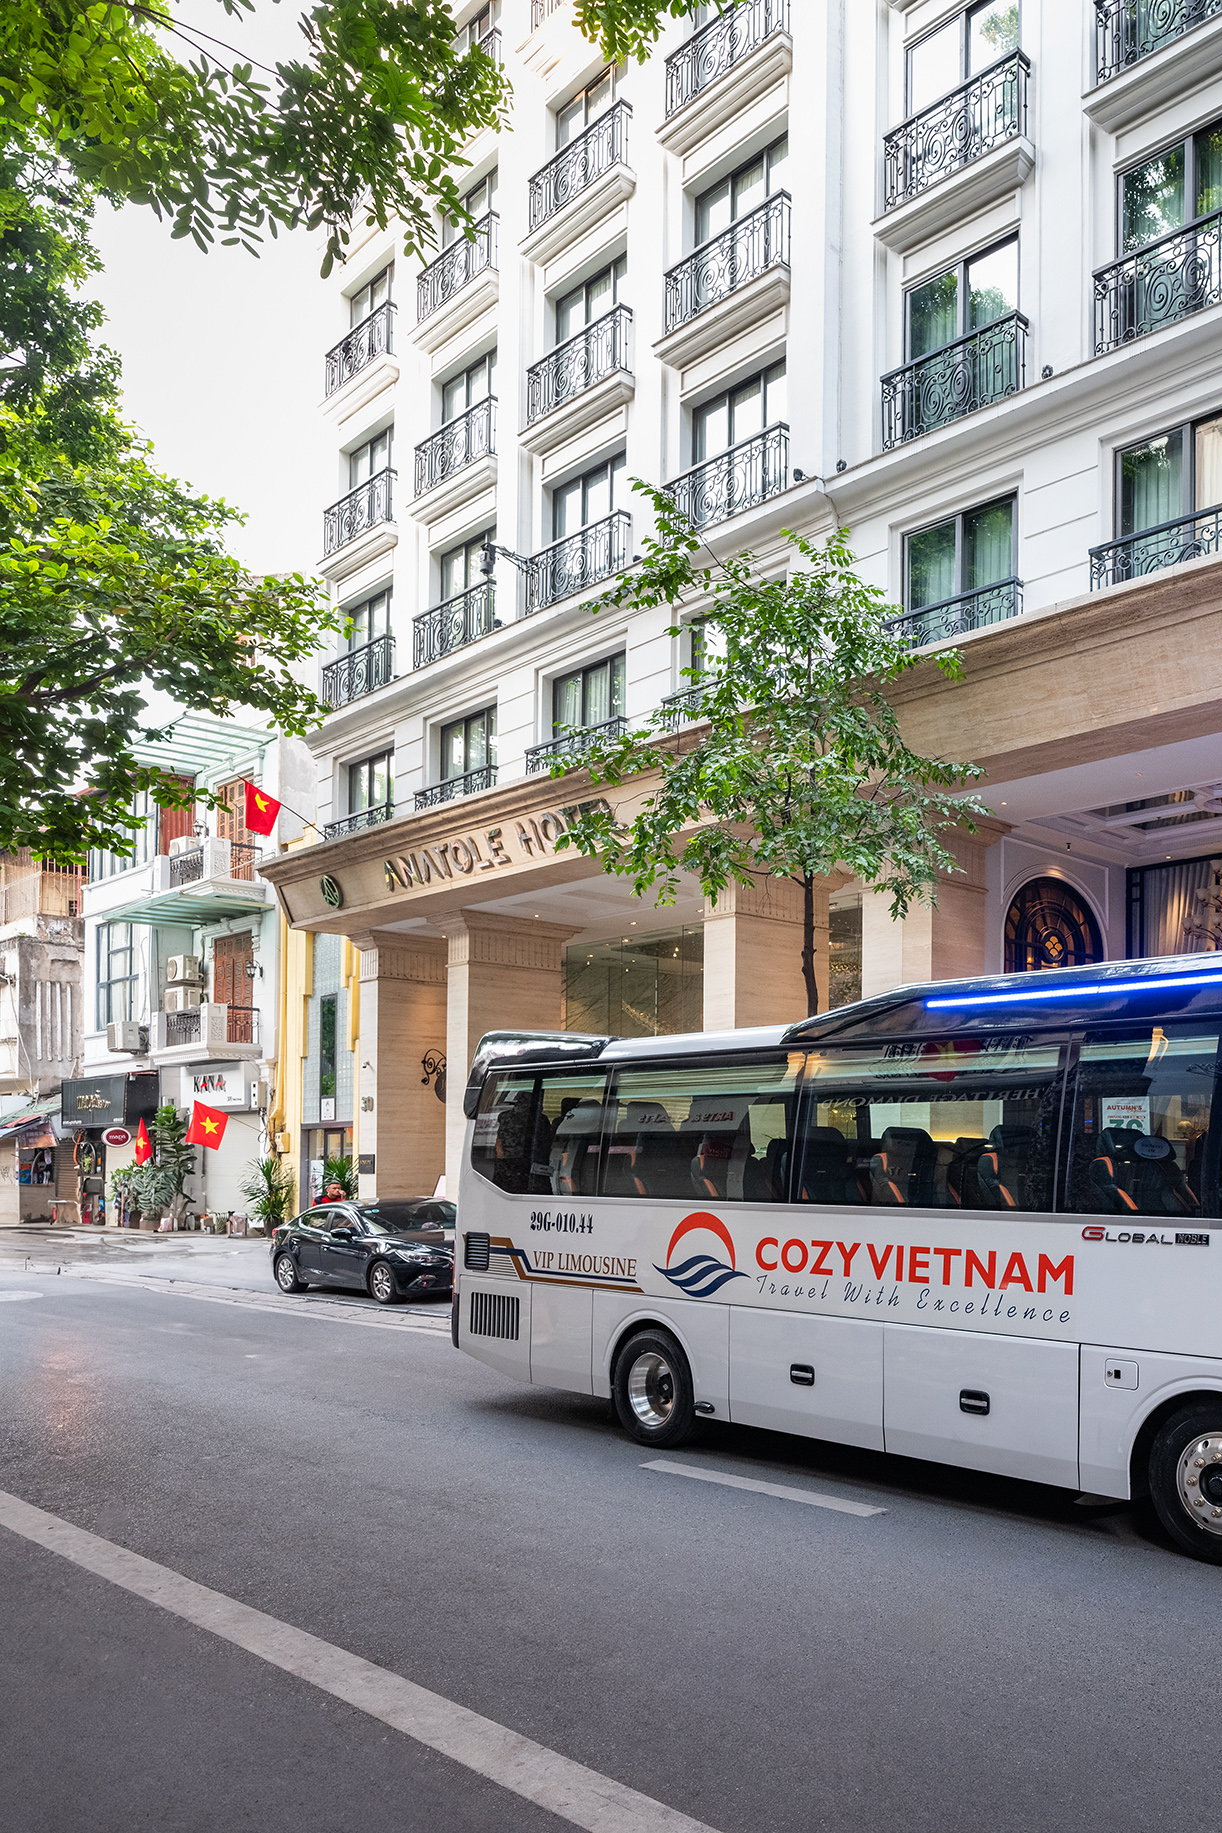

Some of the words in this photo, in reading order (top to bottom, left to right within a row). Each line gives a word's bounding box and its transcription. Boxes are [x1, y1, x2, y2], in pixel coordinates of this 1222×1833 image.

[384, 827, 511, 891] ANATOLE
[193, 1074, 226, 1093] KANA
[530, 1211, 594, 1234] 29G-010.44
[1081, 1226, 1174, 1245] GLOBAL
[1177, 1233, 1208, 1245] NOBLE
[533, 1250, 554, 1270] VIP
[558, 1252, 637, 1277] LIMOUSINE
[756, 1274, 829, 1299] Travel
[843, 1281, 900, 1307] With
[916, 1288, 1070, 1323] Excellence
